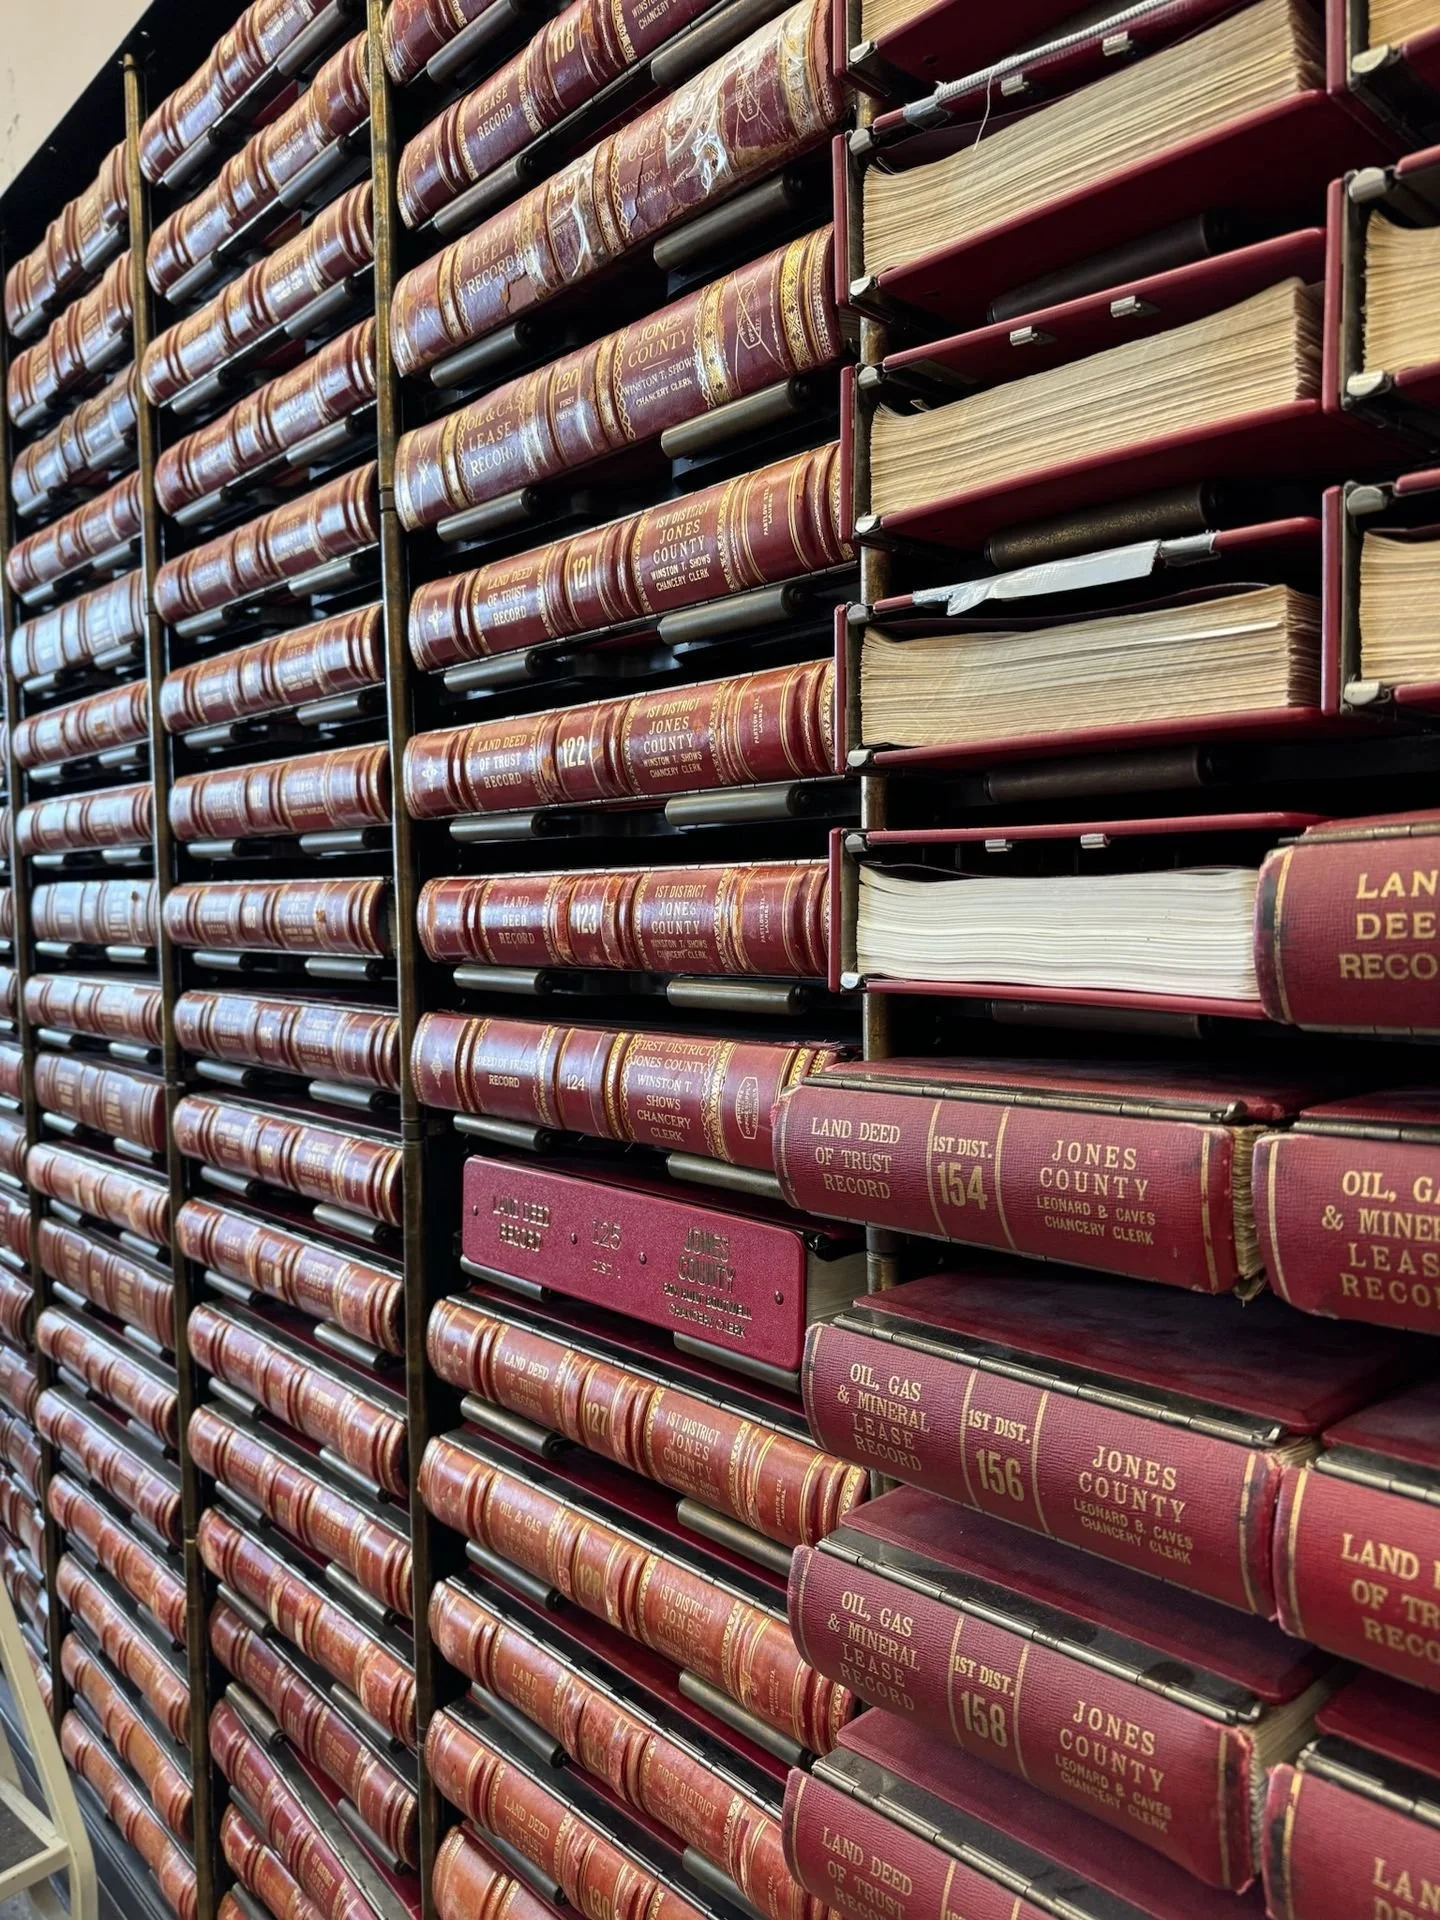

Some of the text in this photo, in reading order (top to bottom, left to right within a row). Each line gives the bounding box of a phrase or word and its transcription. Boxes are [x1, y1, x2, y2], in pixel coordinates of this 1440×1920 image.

[638, 0, 670, 30] CHANCERY
[552, 18, 575, 64] 118
[478, 84, 509, 119] LEASE
[477, 102, 514, 140] RECORD
[472, 238, 509, 272] DEED
[466, 254, 514, 297] RECORD
[637, 312, 684, 346] JONES
[628, 326, 690, 368] COUNTY
[555, 367, 579, 396] 120
[621, 355, 698, 397] WINSTON SHOWS
[636, 377, 693, 408] CHANCERY CLERK
[466, 408, 495, 432] OIL &
[469, 420, 512, 453] LEASE
[470, 445, 518, 477] RECORD
[659, 518, 701, 545] JONES
[652, 535, 706, 564] COUNTY
[487, 565, 533, 591] LAND DEED
[573, 554, 593, 591] 121
[650, 553, 712, 581] WINSTON T. SHOWS
[655, 567, 710, 592] CHANCERY CLERK
[487, 583, 527, 608] OF TRUST
[492, 604, 528, 627] RECORD
[646, 697, 703, 719] 1ST DISTRICT
[649, 716, 690, 736] JONES
[477, 734, 527, 753] LAND DEED
[562, 735, 586, 768] 122
[642, 755, 670, 768] WINSTON
[681, 751, 703, 762] SHOWS
[643, 733, 694, 755] COUNTY
[480, 752, 521, 772] OF TRUST
[649, 763, 702, 779] CHANCERY CLERK
[483, 771, 522, 789] RECORD
[503, 895, 530, 909] LAND
[655, 884, 708, 898] 1ST DISTRICT
[502, 914, 528, 927] DEED
[575, 904, 598, 935] 123
[659, 901, 697, 917] JONES
[498, 932, 536, 945] RECORD
[651, 920, 701, 936] COUNTY
[631, 1054, 709, 1074] JONES COUNTY
[638, 1039, 716, 1057] FIRST DISTRICT
[488, 1074, 520, 1088] RECORD
[566, 1072, 586, 1091] 124
[637, 1074, 694, 1094] WINSTON T.
[646, 1094, 682, 1111] SHOWS
[636, 1109, 692, 1130] CHANCERY
[650, 1127, 686, 1143] CLERK
[811, 1117, 901, 1144] LAND DEED
[815, 1146, 893, 1175] OF TRUST
[932, 1134, 993, 1160] 1ST DIST.
[1051, 1138, 1138, 1171] JONES
[823, 1173, 891, 1200] RECORD
[936, 1161, 988, 1210] 154
[1039, 1166, 1150, 1202] COUNTY
[1341, 1169, 1397, 1203] OIL,
[492, 1195, 550, 1228] LAND DEED
[1036, 1195, 1156, 1226] LEONARD CAVES
[1321, 1204, 1344, 1231] &
[499, 1222, 542, 1253] RECORD
[591, 1217, 622, 1250] 125
[684, 1225, 730, 1262] JONES
[1044, 1215, 1155, 1246] CHANCERY CLERK
[678, 1252, 736, 1294] COUNTY
[715, 1318, 746, 1339] CLERK
[504, 1351, 550, 1381] LAND DEED
[849, 1362, 923, 1402] OIL, GAS
[505, 1371, 544, 1398] OF TRUST
[585, 1401, 610, 1437] 127
[836, 1384, 931, 1434] & MINERAL
[666, 1410, 721, 1447] 1ST DISTRICT
[851, 1412, 916, 1452] LEASE
[966, 1408, 1032, 1446] 1ST DIST.
[669, 1431, 711, 1461] JONES
[854, 1434, 923, 1473] RECORD
[662, 1446, 713, 1481] COUNTY
[974, 1448, 1025, 1502] 156
[1091, 1444, 1179, 1491] JONES
[1078, 1471, 1187, 1524] COUNTY
[500, 1500, 543, 1536] OIL & GAS
[1072, 1497, 1195, 1551] LEONARD CAVES
[1080, 1515, 1193, 1566] CHANCERY CLERK
[1340, 1531, 1421, 1582] LAND
[659, 1583, 715, 1626] 1ST DISTRICT
[1351, 1578, 1389, 1610] OF
[661, 1605, 703, 1639] JONES
[840, 1590, 915, 1638] OIL, GAS
[826, 1613, 922, 1673] & MINERAL
[511, 1662, 538, 1691] LAND
[841, 1643, 906, 1688] LEASE
[953, 1654, 1016, 1698] 1ST DIST.
[839, 1662, 916, 1712] RECORD
[959, 1689, 1009, 1749] 158
[1071, 1699, 1157, 1757] JONES
[1058, 1727, 1165, 1793] COUNTY
[679, 1782, 718, 1821] DISTRICT
[1054, 1753, 1173, 1822] LEONARD CAVES
[1059, 1770, 1170, 1835] CHANCERY CLERK
[503, 1795, 551, 1841] LAND DEED
[517, 1826, 545, 1853] TRUST
[820, 1825, 914, 1898] LAND DEED
[826, 1860, 907, 1920] OF TRUST
